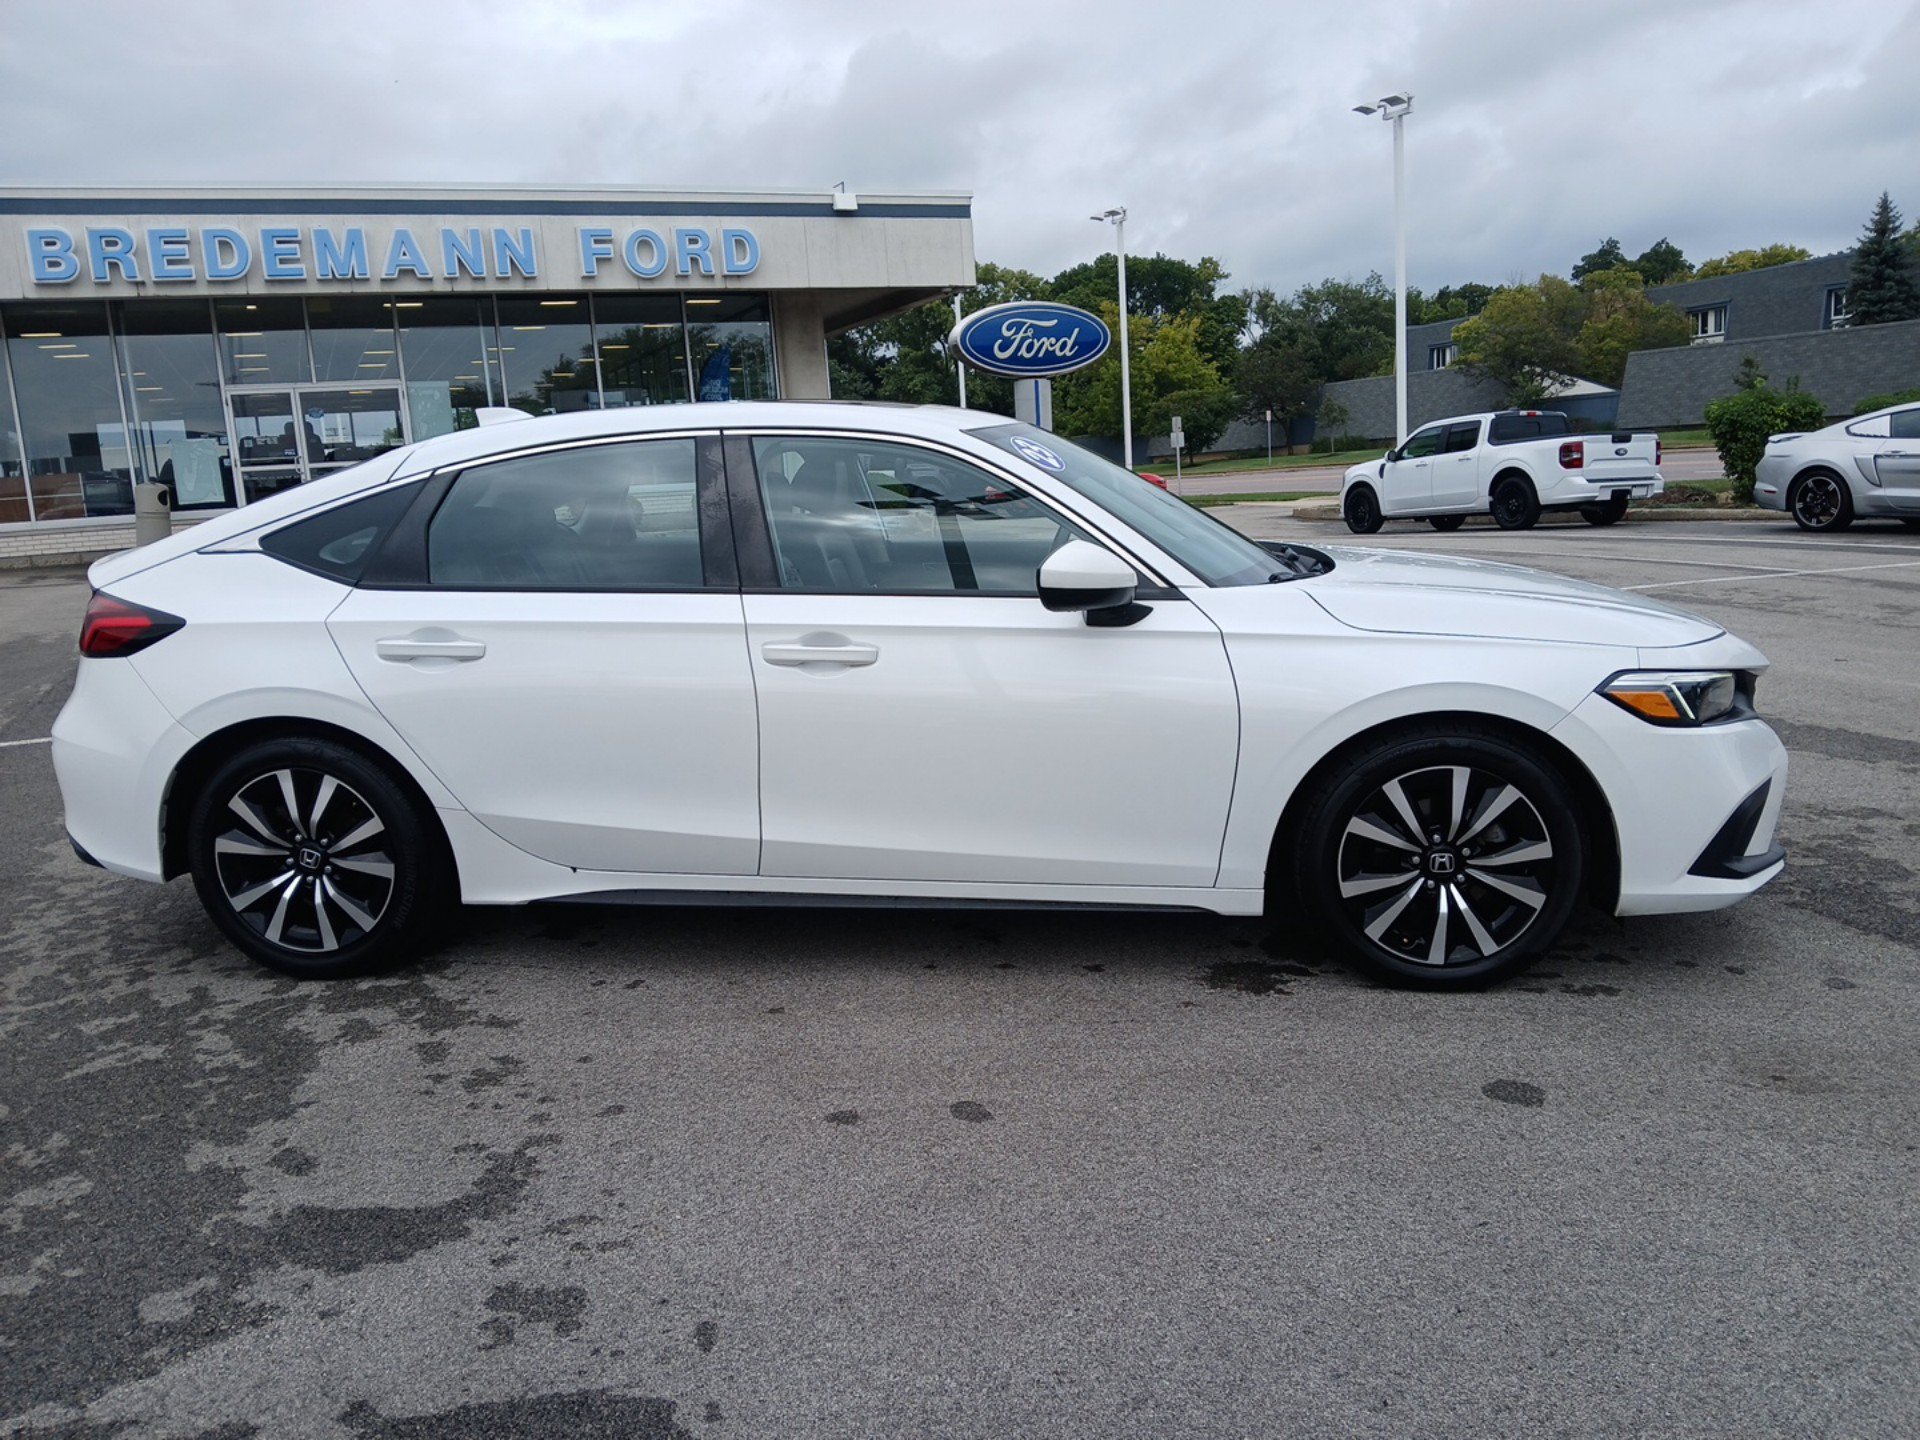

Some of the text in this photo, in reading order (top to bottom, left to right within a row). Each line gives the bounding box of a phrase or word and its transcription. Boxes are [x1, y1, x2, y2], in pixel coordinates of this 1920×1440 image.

[25, 226, 762, 284] BREDEMANN FORD
[993, 318, 1080, 359] Ford
